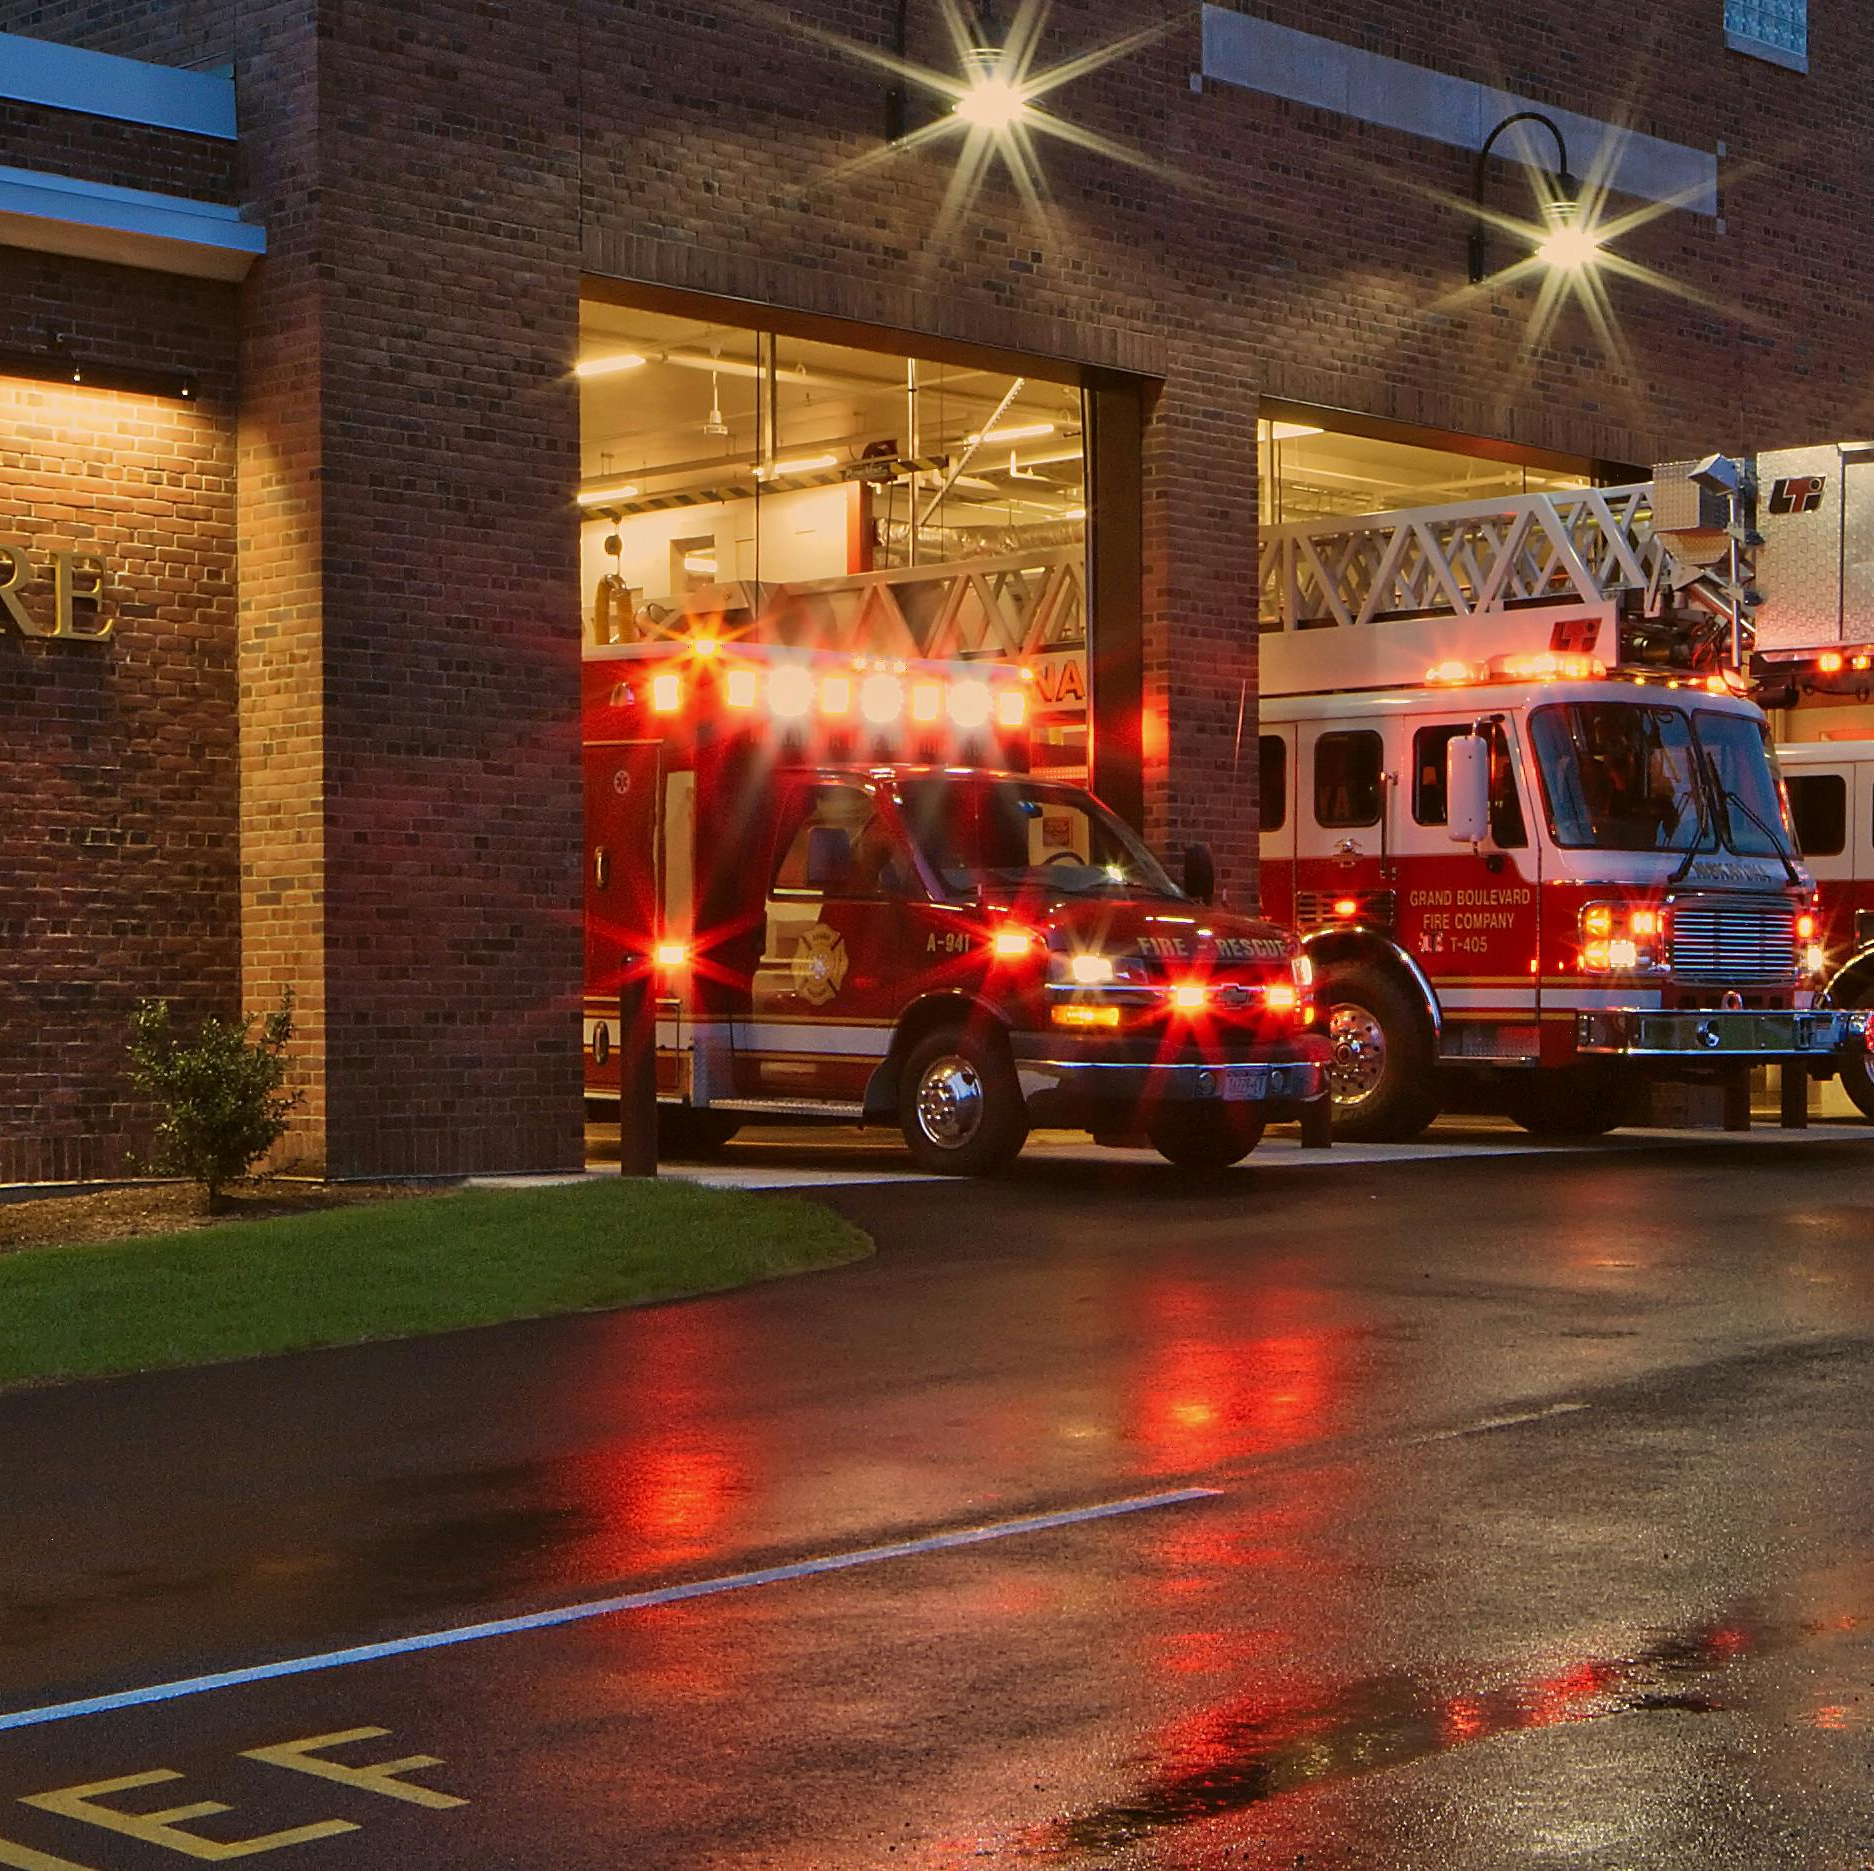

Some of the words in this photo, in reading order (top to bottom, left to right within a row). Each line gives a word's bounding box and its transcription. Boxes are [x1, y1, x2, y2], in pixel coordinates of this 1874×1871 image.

[1409, 889, 1452, 906] GRAND
[1456, 888, 1531, 906] BOULEVARD
[1423, 913, 1450, 929] FIRE
[1454, 912, 1515, 929] COMPANY
[1137, 936, 1188, 957] FIRE
[1213, 937, 1288, 958] RESCUE
[1450, 936, 1488, 953] T-405
